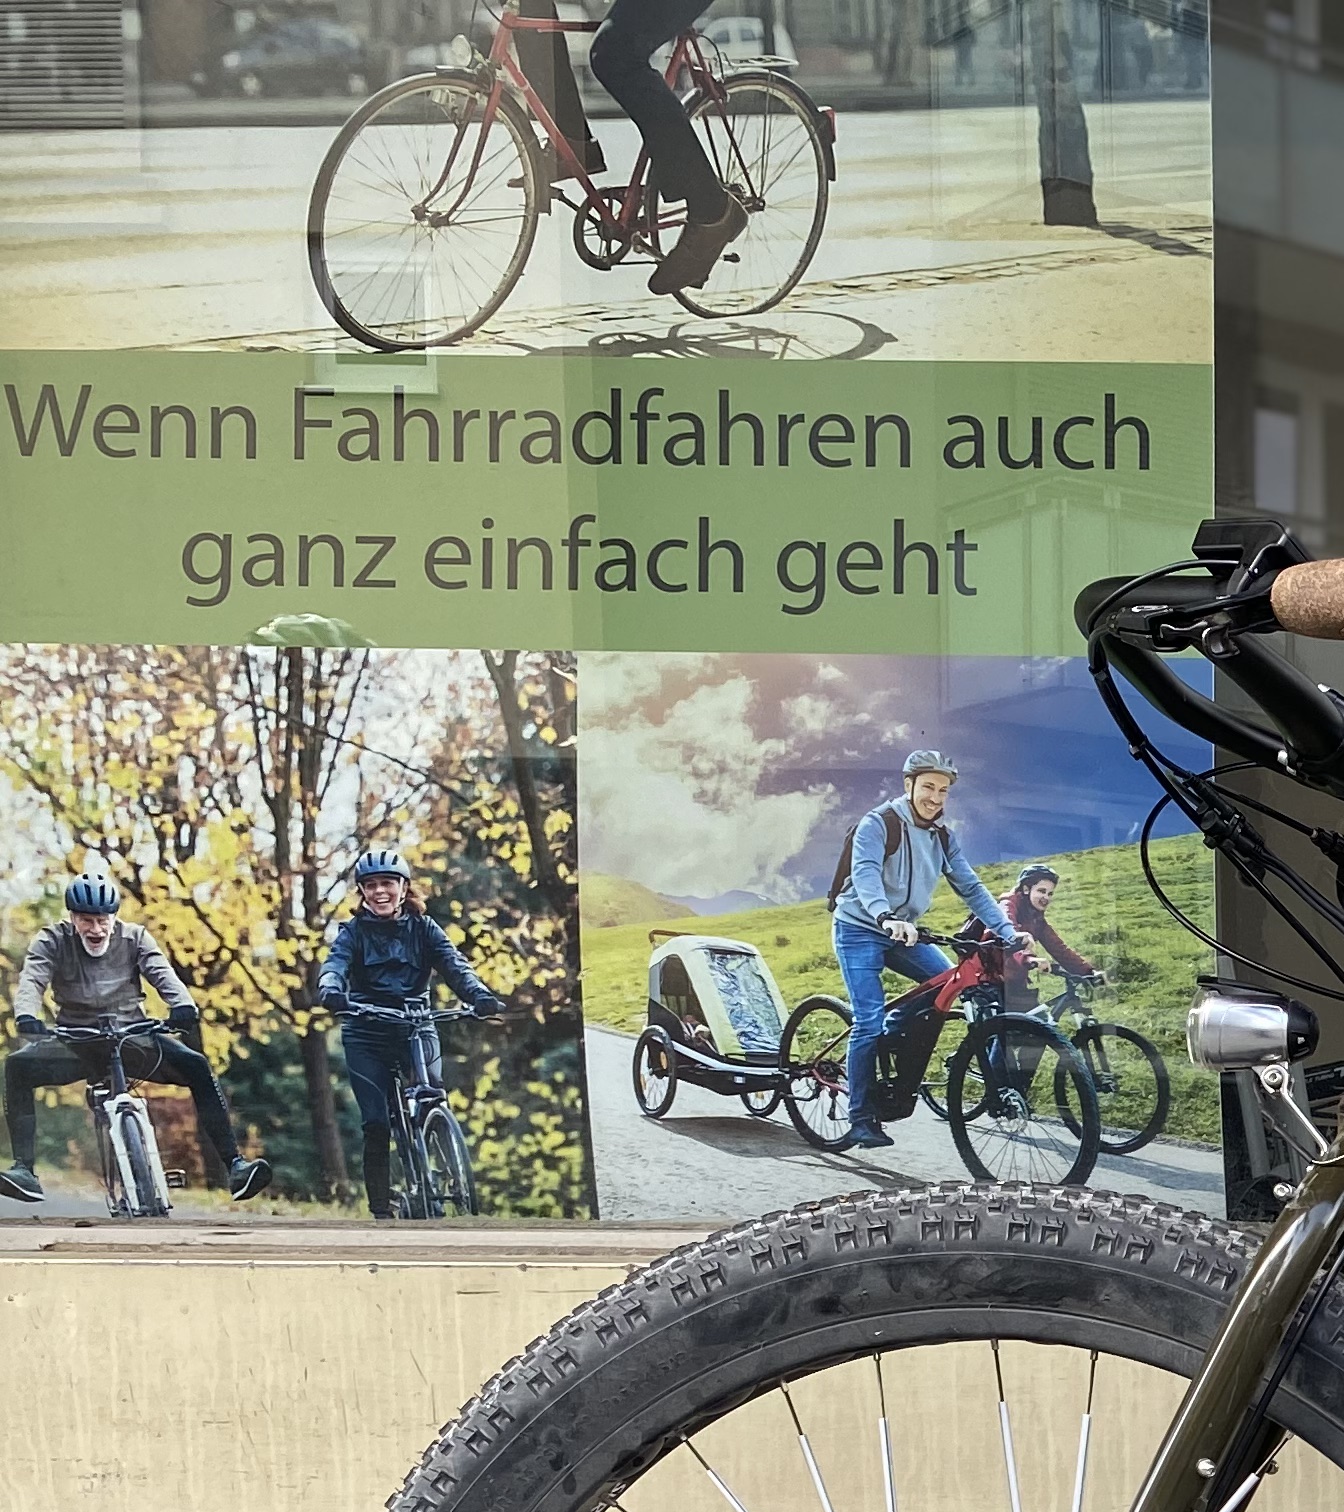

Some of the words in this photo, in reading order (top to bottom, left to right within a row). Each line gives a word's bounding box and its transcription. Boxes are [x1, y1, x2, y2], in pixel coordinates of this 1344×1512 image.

[4, 383, 257, 460] Wenn
[293, 386, 911, 469] Fahrradfahren
[944, 393, 1150, 471] auch
[182, 531, 396, 607] ganz
[424, 514, 743, 595] einfach
[777, 519, 978, 615] geht
